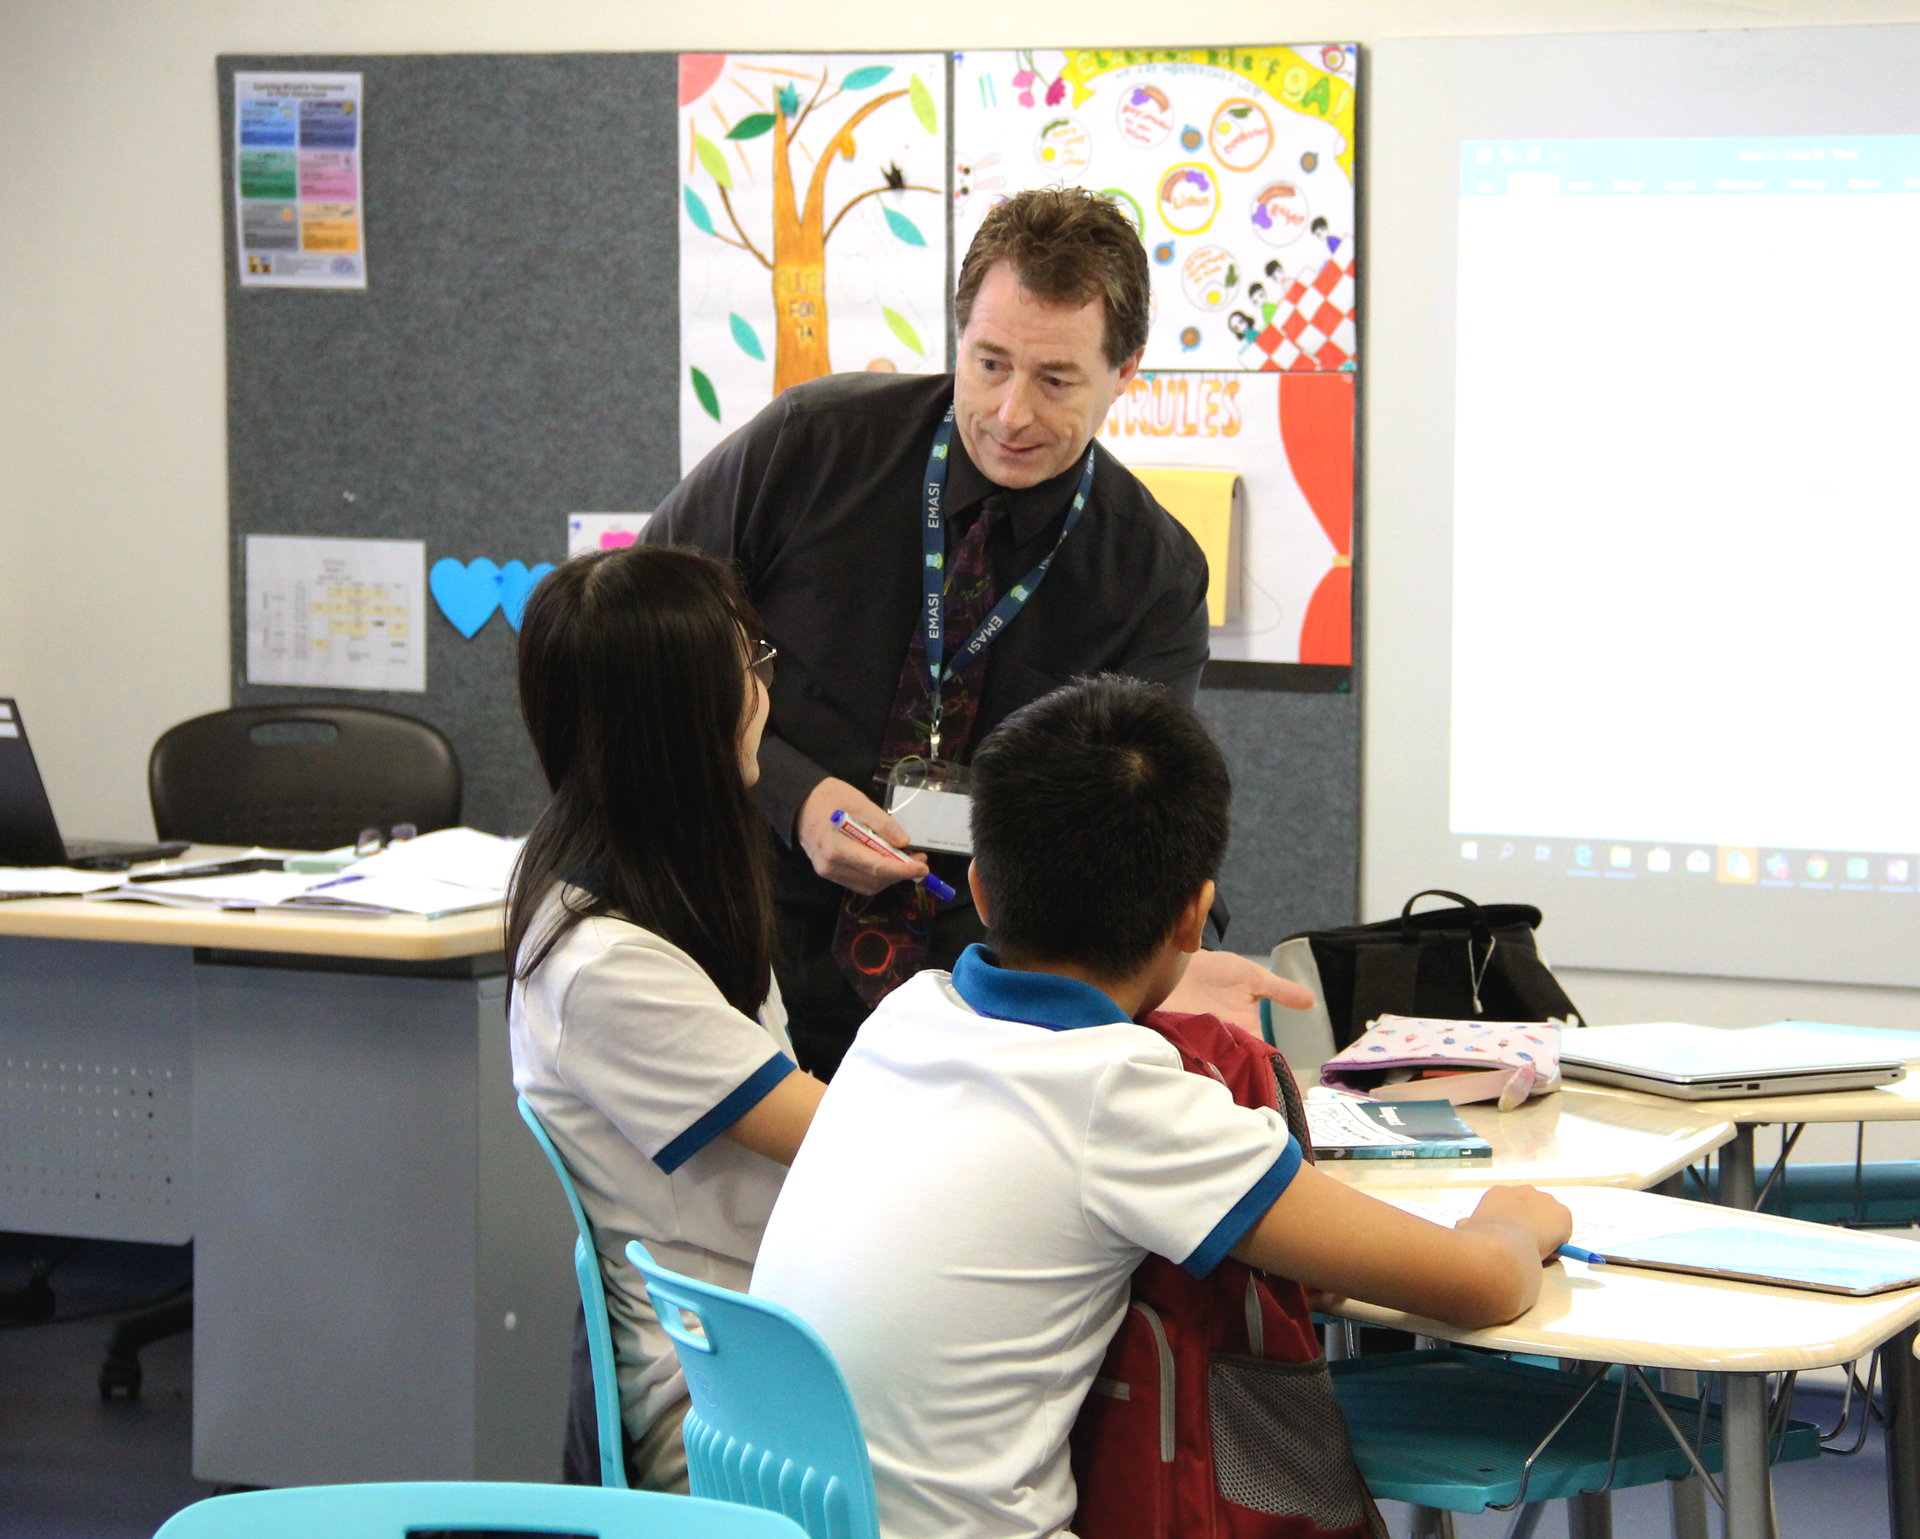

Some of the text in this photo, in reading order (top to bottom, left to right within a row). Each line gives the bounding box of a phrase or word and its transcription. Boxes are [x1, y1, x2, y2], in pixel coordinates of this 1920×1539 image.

[1124, 378, 1242, 437] RULES
[927, 482, 940, 529] EMASI
[928, 591, 940, 640] EMASI
[967, 614, 1004, 656] EMASI
